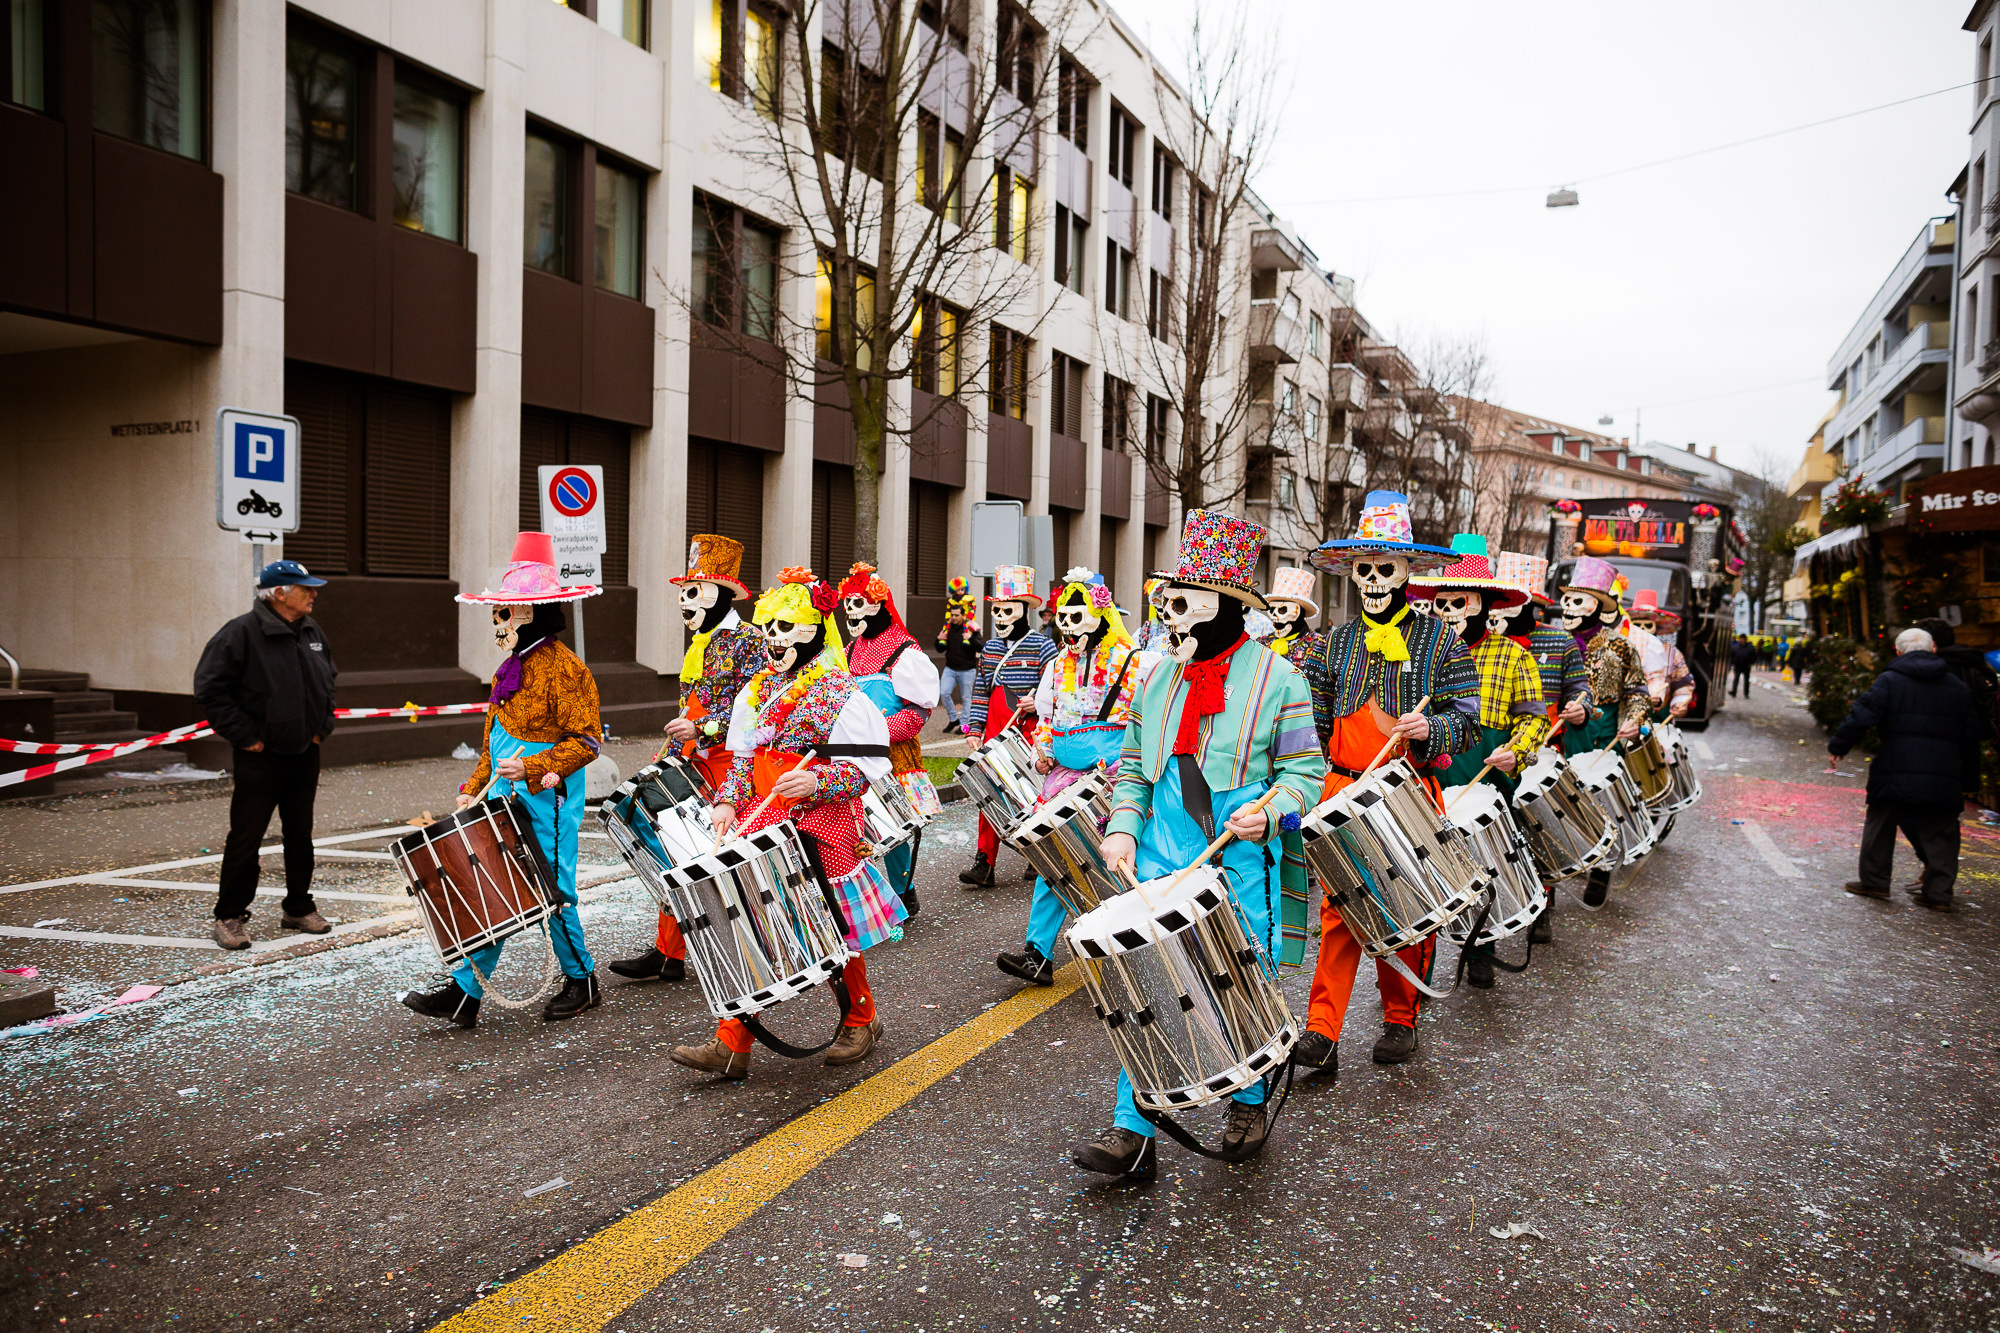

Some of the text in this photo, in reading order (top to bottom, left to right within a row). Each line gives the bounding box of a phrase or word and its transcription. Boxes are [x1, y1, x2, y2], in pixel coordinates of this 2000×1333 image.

[111, 420, 200, 437] WETTSTEINPLATZ 1
[248, 432, 274, 474] P
[1921, 489, 2000, 513] Mir fe
[553, 534, 599, 543] Zweiradparking
[559, 545, 594, 554] aufgehoben
